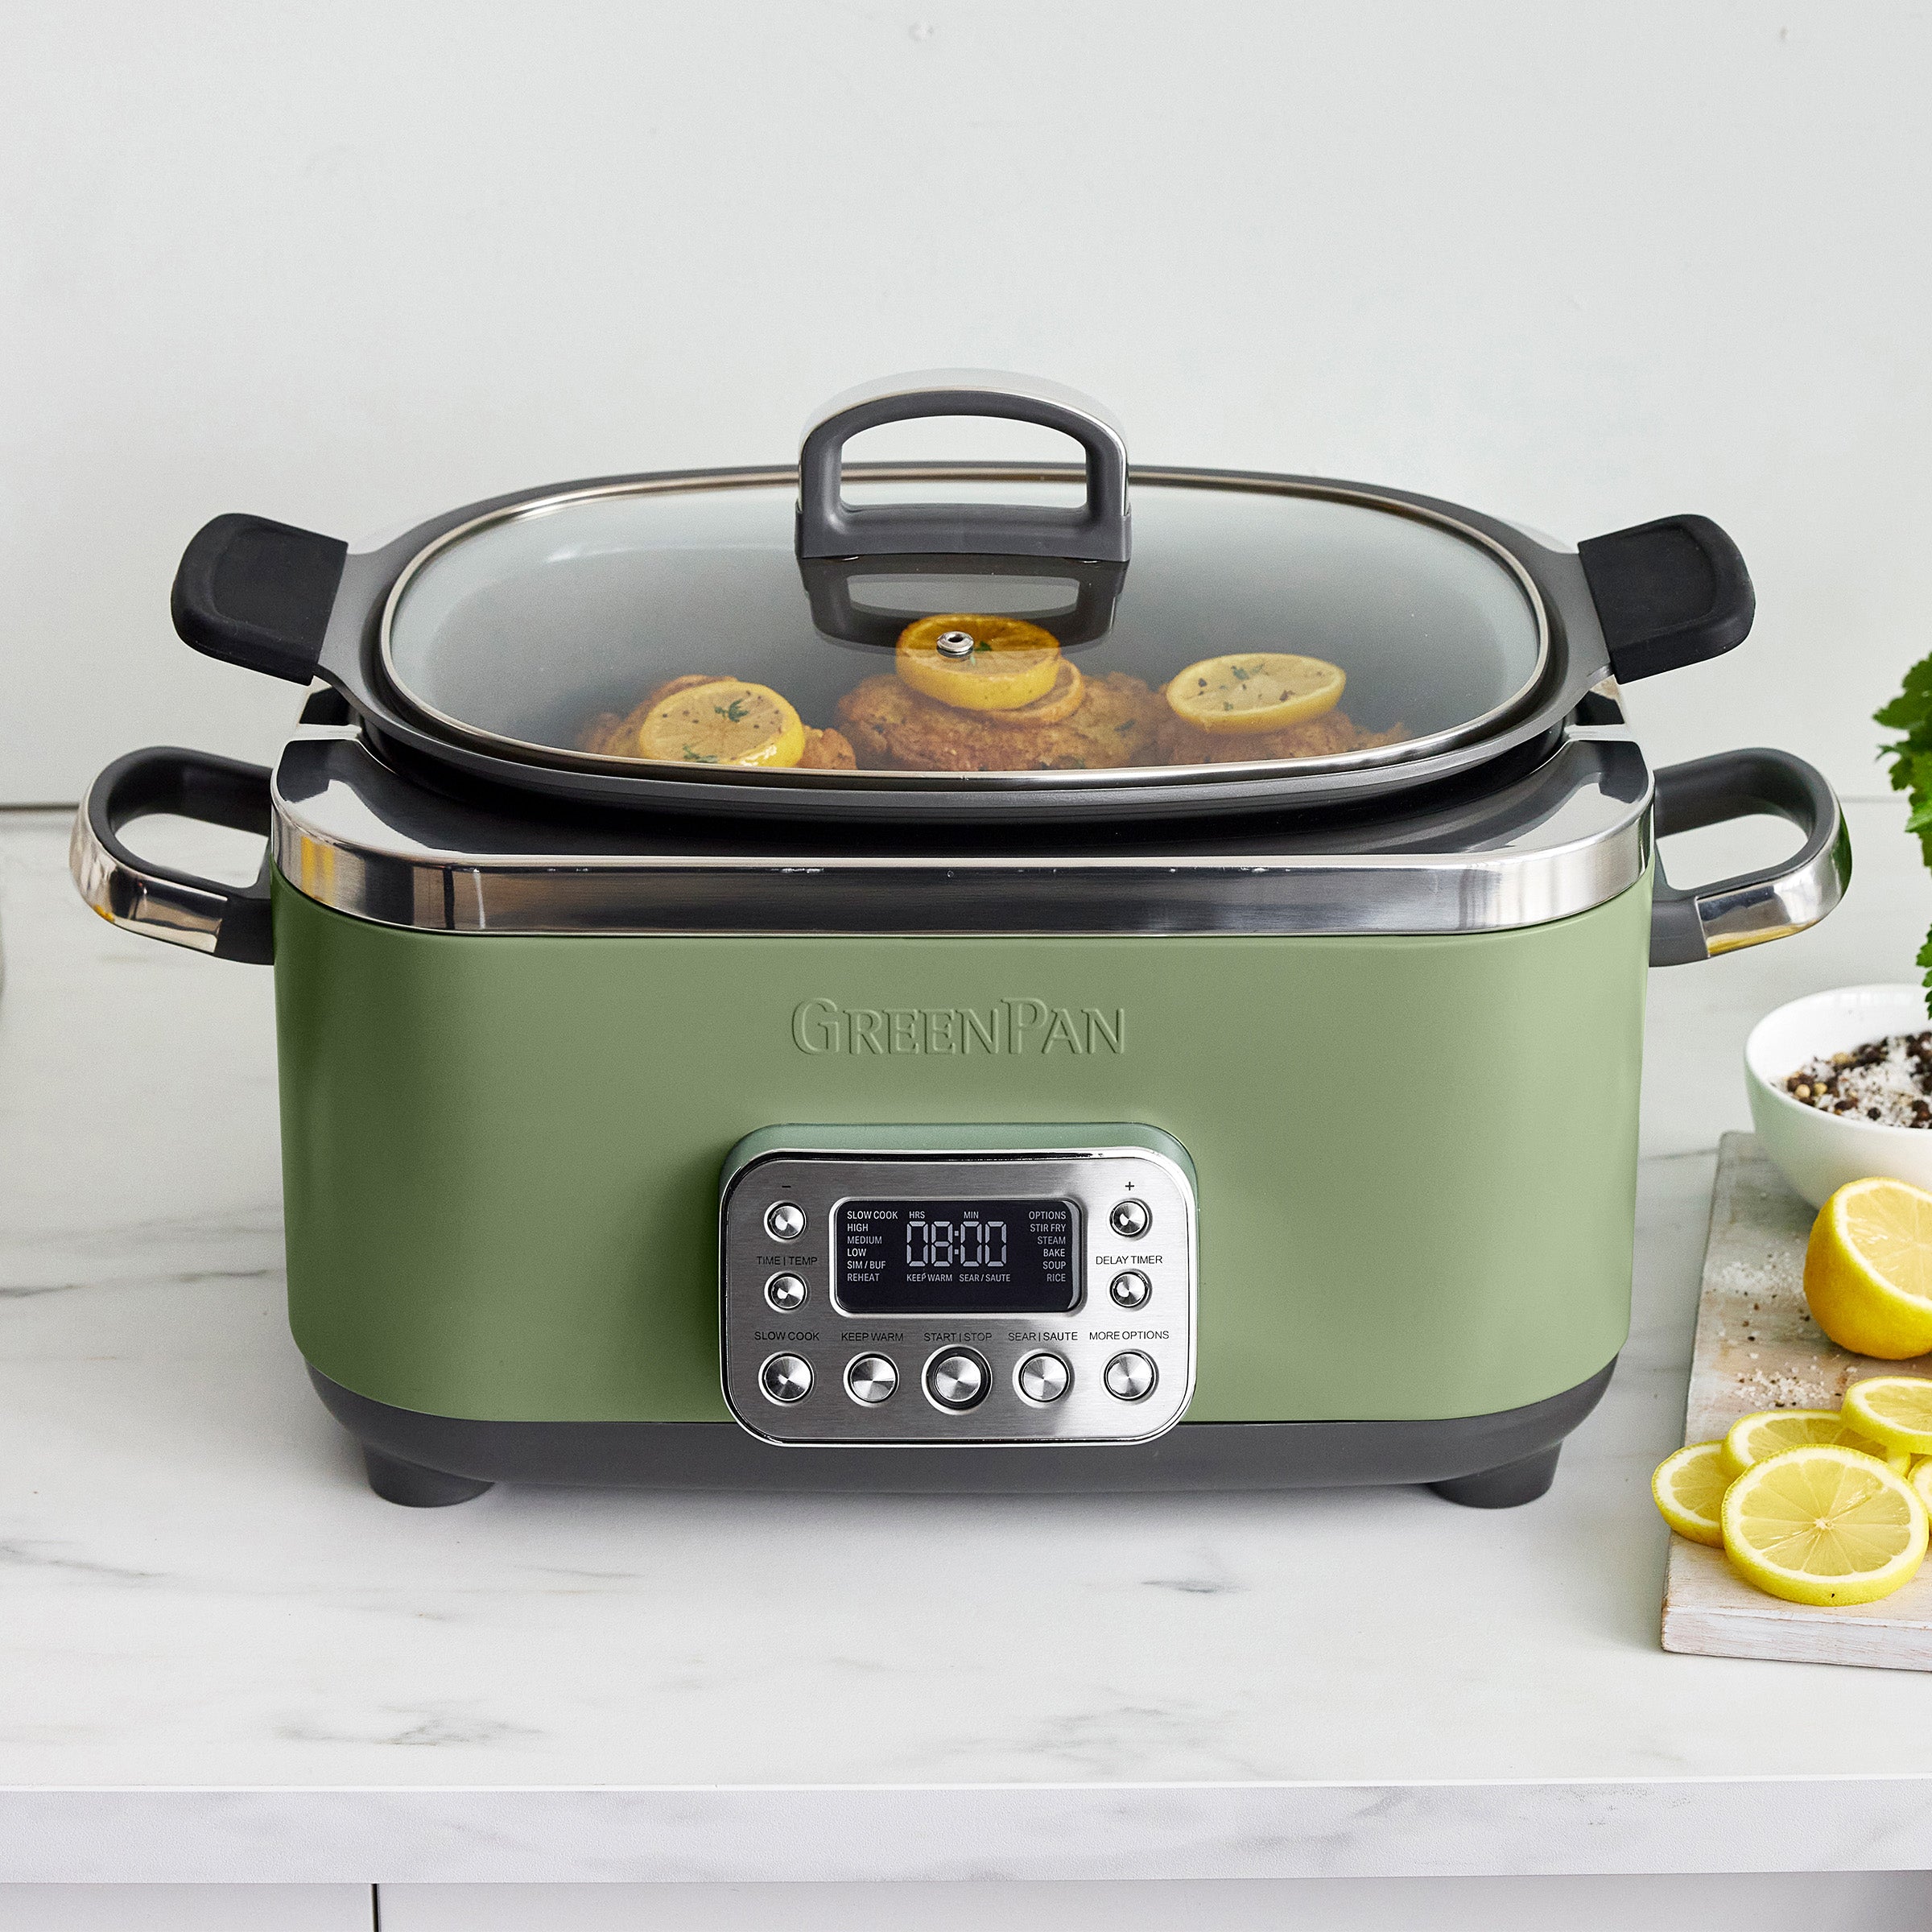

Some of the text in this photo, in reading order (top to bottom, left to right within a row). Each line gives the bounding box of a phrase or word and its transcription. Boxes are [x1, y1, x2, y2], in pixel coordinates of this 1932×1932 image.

[847, 1211, 898, 1220] SLOW COOK
[909, 1211, 926, 1220] HRS
[964, 1211, 979, 1220] MIN
[1028, 1211, 1067, 1220] OPTIONS
[847, 1224, 869, 1232] HIGH
[1030, 1224, 1067, 1232] STIR FRY
[847, 1236, 882, 1245] MEDIUM
[906, 1220, 1007, 1267] 08:00
[1037, 1236, 1066, 1245] STEAM
[847, 1249, 867, 1257] LOW
[1043, 1249, 1066, 1257] BAKE
[757, 1256, 781, 1265] TIME
[789, 1256, 818, 1265] TEMP
[1096, 1255, 1162, 1265] DELAY TIMER
[847, 1261, 864, 1269] SIM
[869, 1261, 886, 1269] BUF
[1042, 1261, 1067, 1269] SOUP
[847, 1273, 880, 1282] REHEAT
[906, 1274, 953, 1282] KEEP WARM
[959, 1274, 980, 1282] SEAR
[985, 1274, 1011, 1282] SAUTE
[1046, 1273, 1066, 1282] RICE
[753, 1331, 819, 1341] SLOW COOK
[841, 1332, 904, 1342] KEEP WARM
[923, 1332, 956, 1342] START
[964, 1332, 993, 1342] STOP
[1008, 1332, 1036, 1342] SEAR
[1042, 1331, 1079, 1341] SAUTE
[1089, 1331, 1170, 1341] MORE OPTIONS
